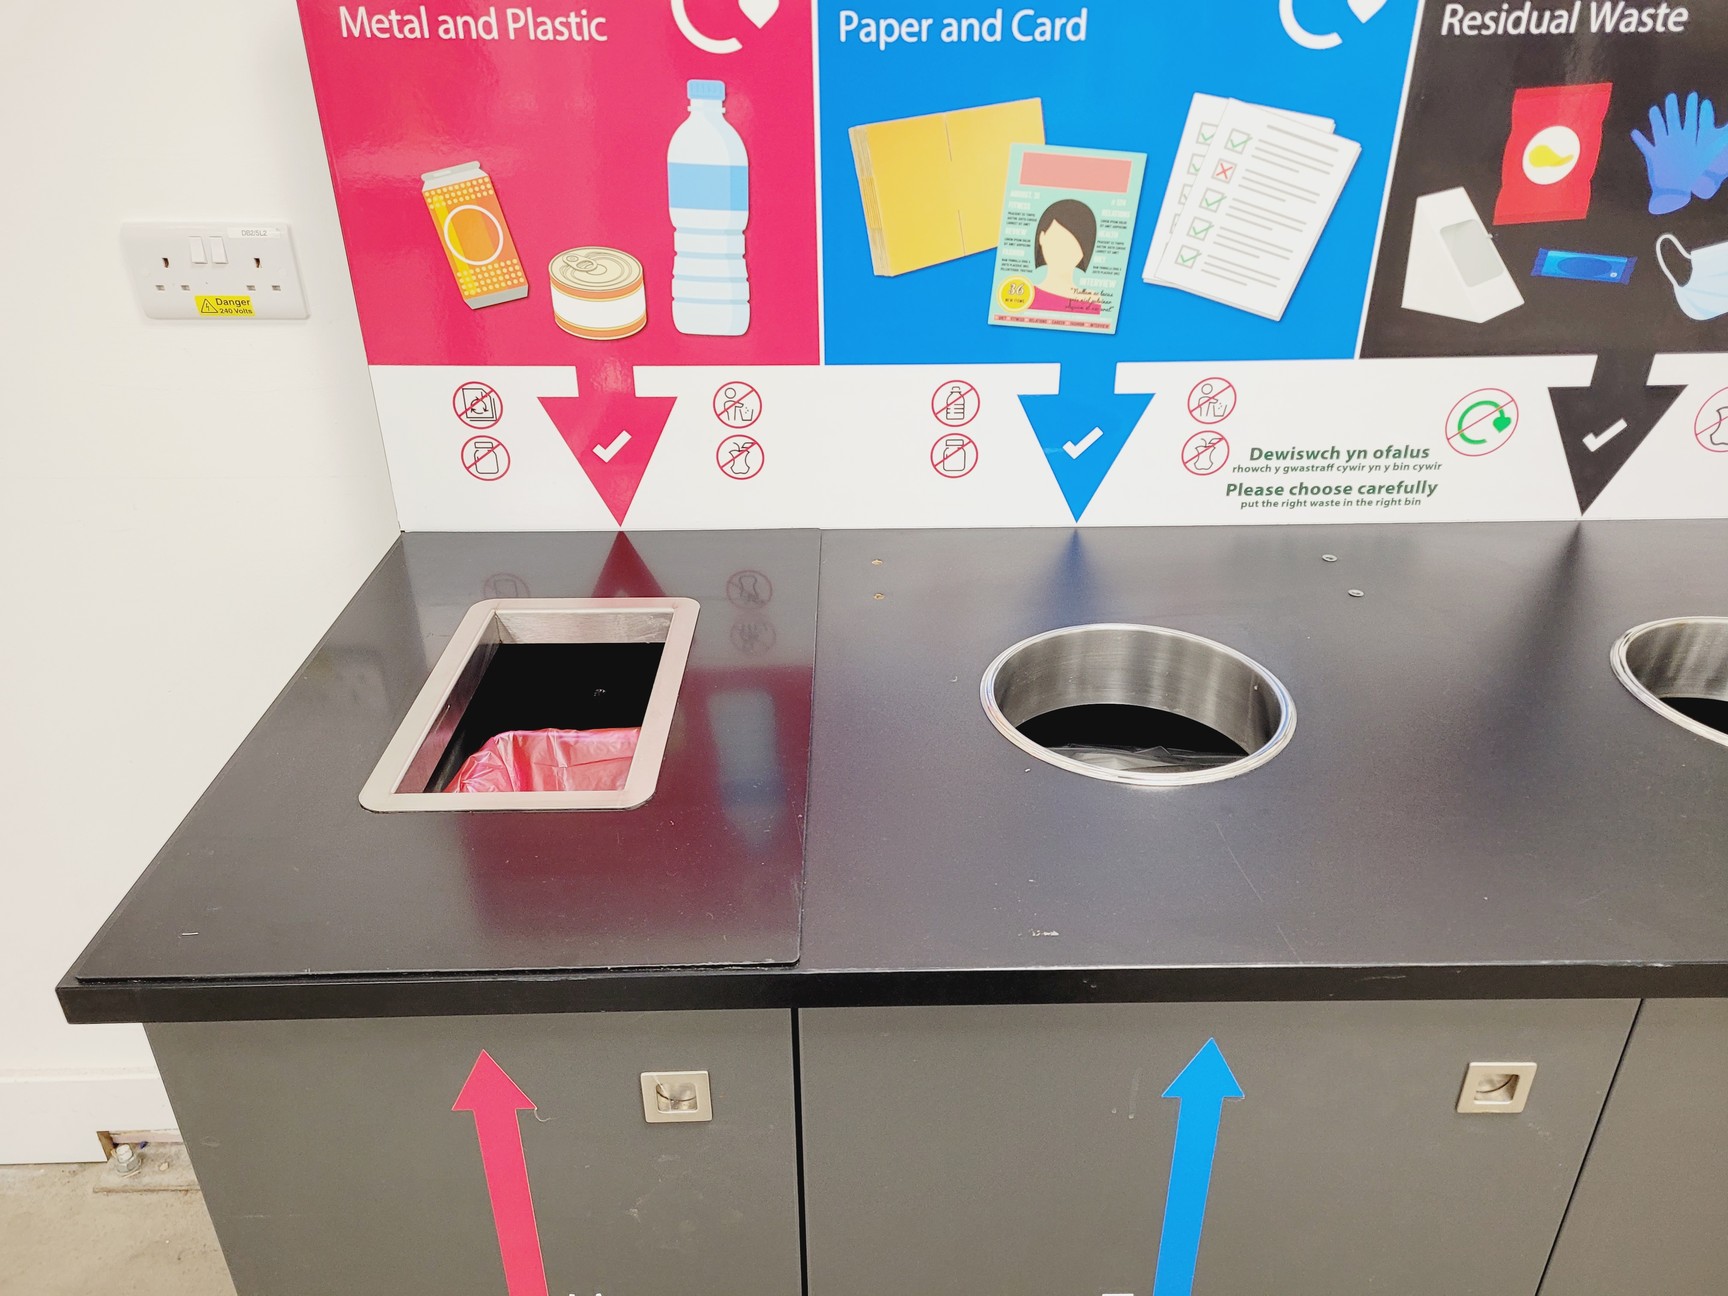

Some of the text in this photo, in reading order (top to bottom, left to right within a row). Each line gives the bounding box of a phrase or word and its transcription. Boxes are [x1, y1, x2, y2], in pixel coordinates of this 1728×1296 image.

[338, 5, 608, 42] Metal and Plastic
[1441, 0, 1690, 36] Residual Waste
[839, 7, 1088, 51] Paper and Card
[1008, 282, 1025, 296] 36
[215, 297, 250, 308] Danger
[1249, 444, 1430, 463] Dewiswch yn ofalus
[1232, 462, 1442, 475] rhowch y gwastraff cywir yn y bin cywir
[1226, 480, 1439, 498] Please choose carefully
[1240, 497, 1422, 510] put the right waste in the right bin
